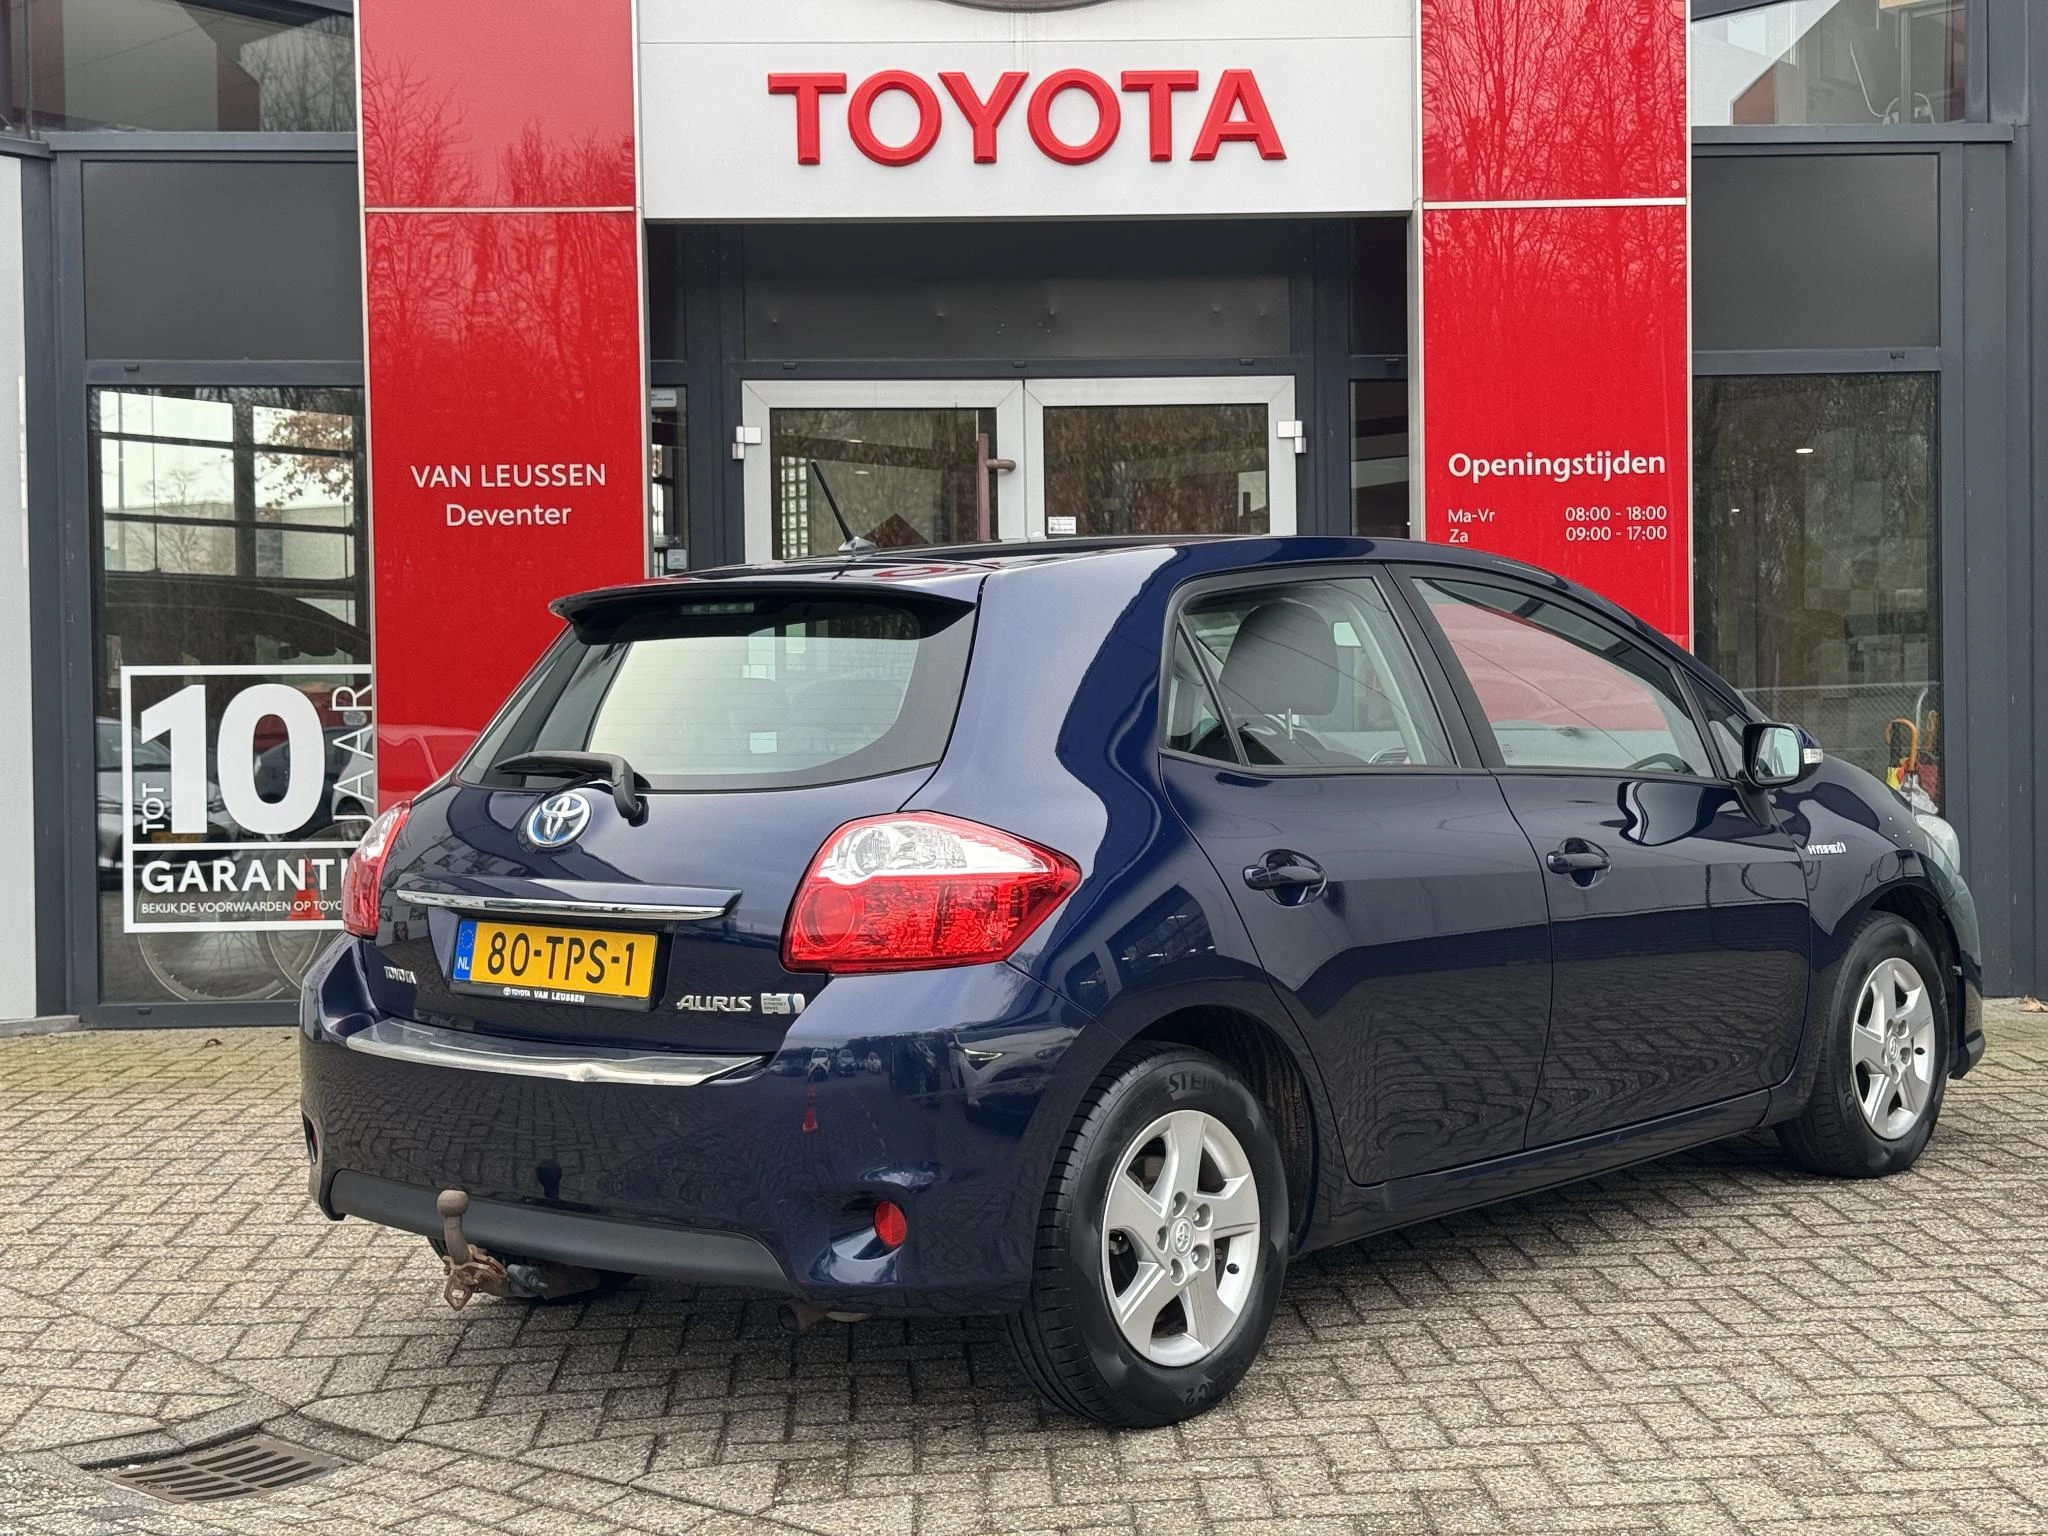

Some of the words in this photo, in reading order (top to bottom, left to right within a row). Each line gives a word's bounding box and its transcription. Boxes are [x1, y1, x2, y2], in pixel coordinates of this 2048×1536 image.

[768, 68, 1287, 166] TOYOTA
[410, 465, 471, 488] VAN
[480, 463, 606, 487] LEUSSEN
[1448, 450, 1666, 484] Openingstijden
[446, 503, 572, 527] Deventer
[1448, 508, 1495, 523] Ma-Vr
[1565, 507, 1611, 521] 08:00
[1626, 506, 1667, 521] 18:00
[1448, 529, 1469, 543] Za
[1565, 526, 1612, 542] 09:00
[1626, 525, 1668, 541] 17:00
[140, 683, 326, 835] 10
[141, 783, 165, 834] TOT
[141, 902, 178, 914] BEKIJK
[180, 902, 197, 914] DE
[198, 900, 291, 913] VOORWAARDEN
[293, 900, 312, 912] OP
[457, 956, 470, 971] NL
[487, 931, 635, 987] 80-TPS-1
[383, 965, 417, 985] TOYOTA
[534, 990, 549, 1000] VAN
[551, 991, 586, 1004] LEUSSEN
[676, 994, 752, 1012] AURIS
